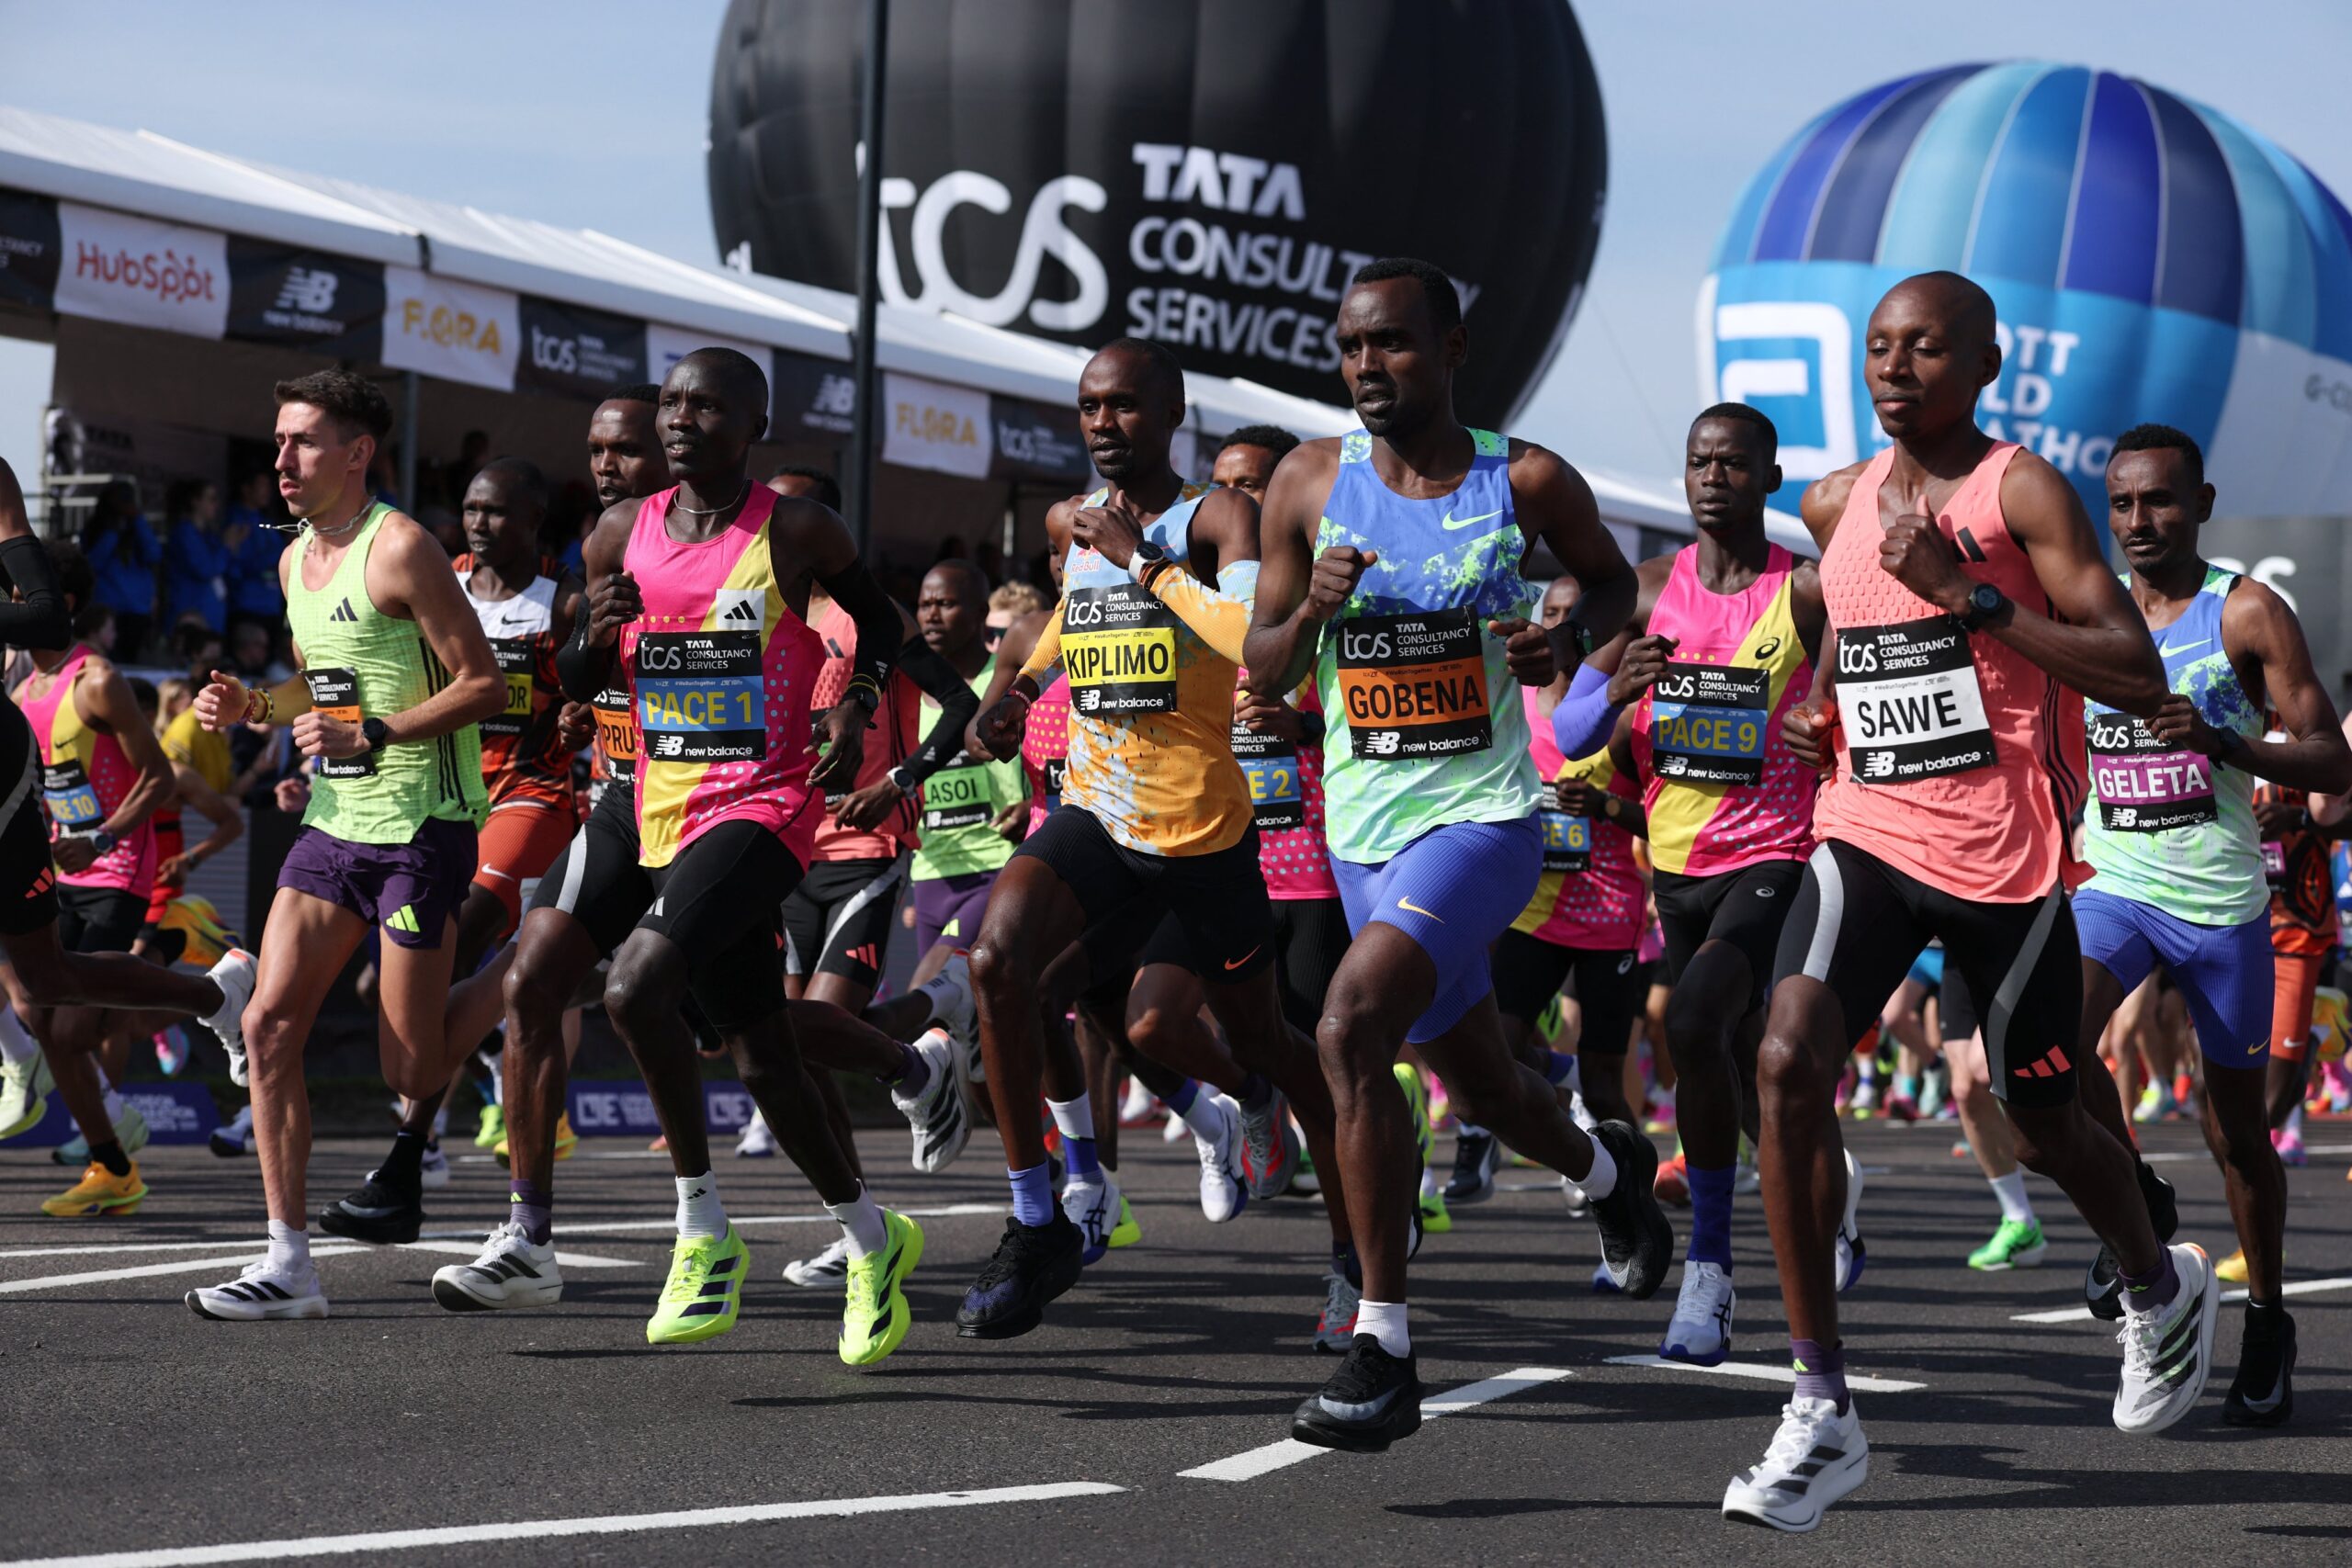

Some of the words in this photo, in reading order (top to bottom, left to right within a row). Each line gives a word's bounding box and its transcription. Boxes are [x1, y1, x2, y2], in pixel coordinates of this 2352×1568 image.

[1132, 142, 1305, 220] TATA
[76, 239, 216, 302] HubSpot
[531, 324, 578, 374] tcs
[1107, 592, 1129, 602] TATA
[1068, 598, 1102, 626] tcs
[1105, 601, 1164, 612] CONSULTANCY
[1104, 612, 1141, 623] SERVICES
[1396, 622, 1426, 633] TATA
[685, 639, 714, 649] TATA
[1343, 626, 1392, 660] tcs
[1396, 626, 1470, 646] CONSULTANCY
[1877, 632, 1908, 646] TATA
[685, 649, 752, 660] CONSULTANCY
[1397, 643, 1445, 658] SERVICES
[1839, 637, 1878, 673] tcs
[1880, 636, 1956, 658] CONSULTANCY
[641, 640, 682, 671] tcs
[1066, 642, 1169, 679] KIPLIMO
[1883, 655, 1929, 671] SERVICES
[686, 660, 729, 670] SERVICES
[1385, 668, 1432, 676] #WeRunTogether
[314, 675, 330, 684] TATA
[1700, 671, 1725, 681] TATA
[316, 682, 353, 693] CONSULTANCY
[1699, 681, 1761, 694] CONSULTANCY
[1874, 681, 1919, 691] #WeRunTogether
[318, 693, 339, 702] SERVICES
[1102, 700, 1117, 709] new
[1118, 697, 1164, 707] balance
[1349, 675, 1483, 720] GOBENA
[1698, 690, 1737, 701] SERVICES
[645, 691, 727, 726] PACE
[735, 691, 752, 723] 1
[1858, 689, 1962, 739] SAWE
[1658, 714, 1732, 750] PACE
[1737, 722, 1757, 753] 9
[2092, 722, 2130, 749] tcs
[685, 747, 706, 757] new
[707, 746, 752, 757] balance
[1231, 745, 1265, 753] SERVICES
[1402, 742, 1427, 753] new
[1429, 736, 1480, 751] balance
[338, 764, 367, 774] balance
[1898, 761, 1924, 775] new
[1925, 750, 1982, 772] balance
[1272, 769, 1292, 797] 2
[1687, 769, 1707, 779] new
[1708, 769, 1750, 781] balance
[2098, 763, 2208, 798] GELETA
[73, 795, 96, 819] 10
[2139, 818, 2160, 828] new
[2161, 811, 2205, 826] balance
[1568, 824, 1584, 848] 6
